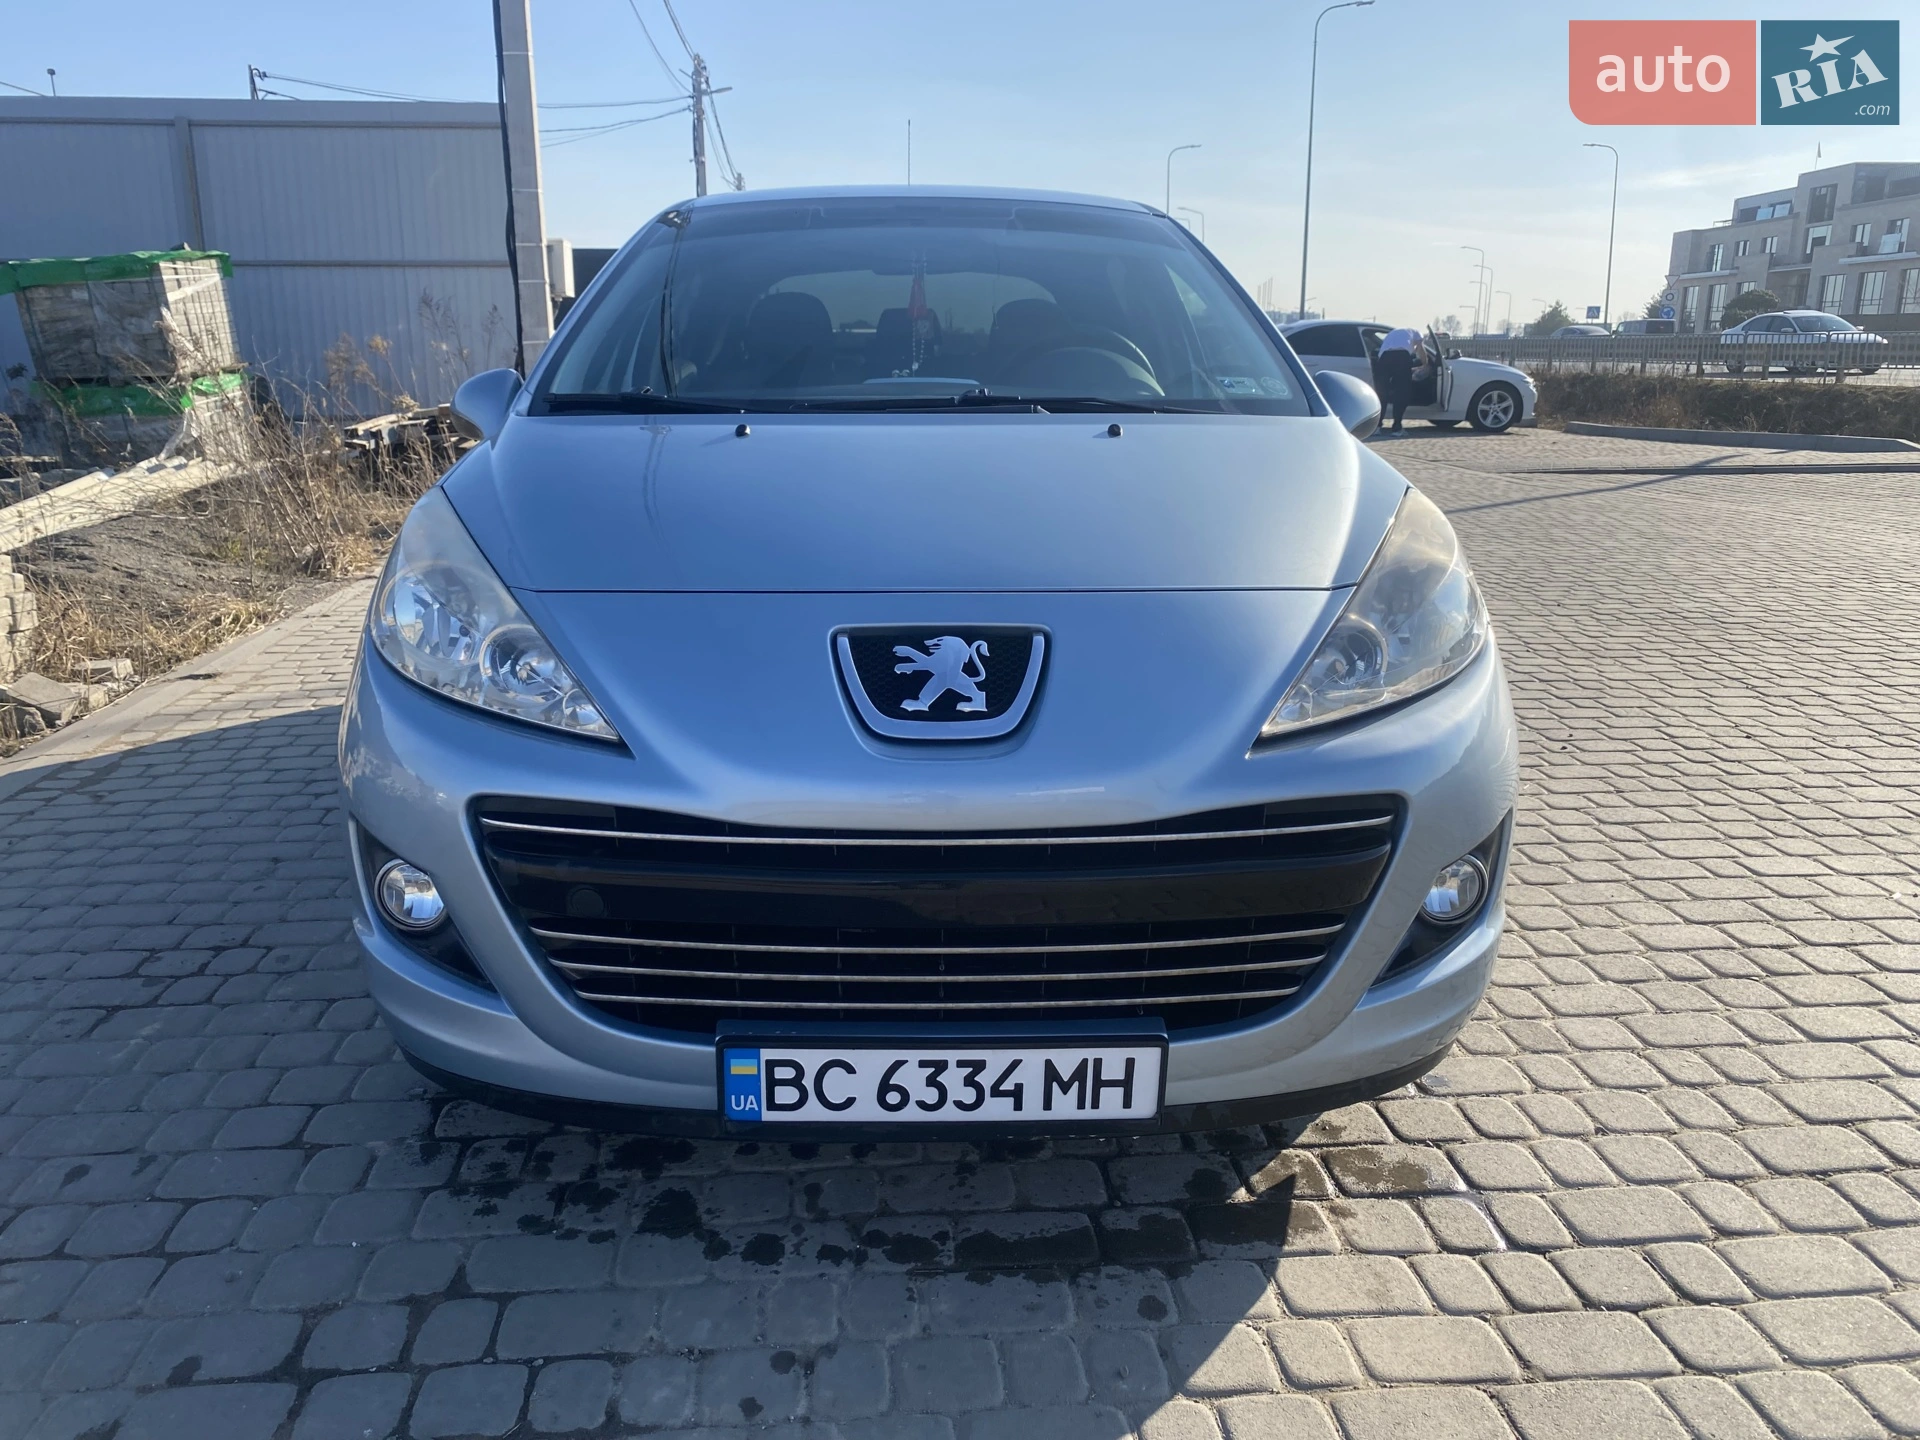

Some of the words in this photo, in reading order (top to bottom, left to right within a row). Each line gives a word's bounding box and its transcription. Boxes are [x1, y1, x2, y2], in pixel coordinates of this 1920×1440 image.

[731, 1094, 759, 1112] UA
[764, 1058, 858, 1113] BC
[876, 1058, 1024, 1113] 6334
[1042, 1056, 1136, 1111] MH
